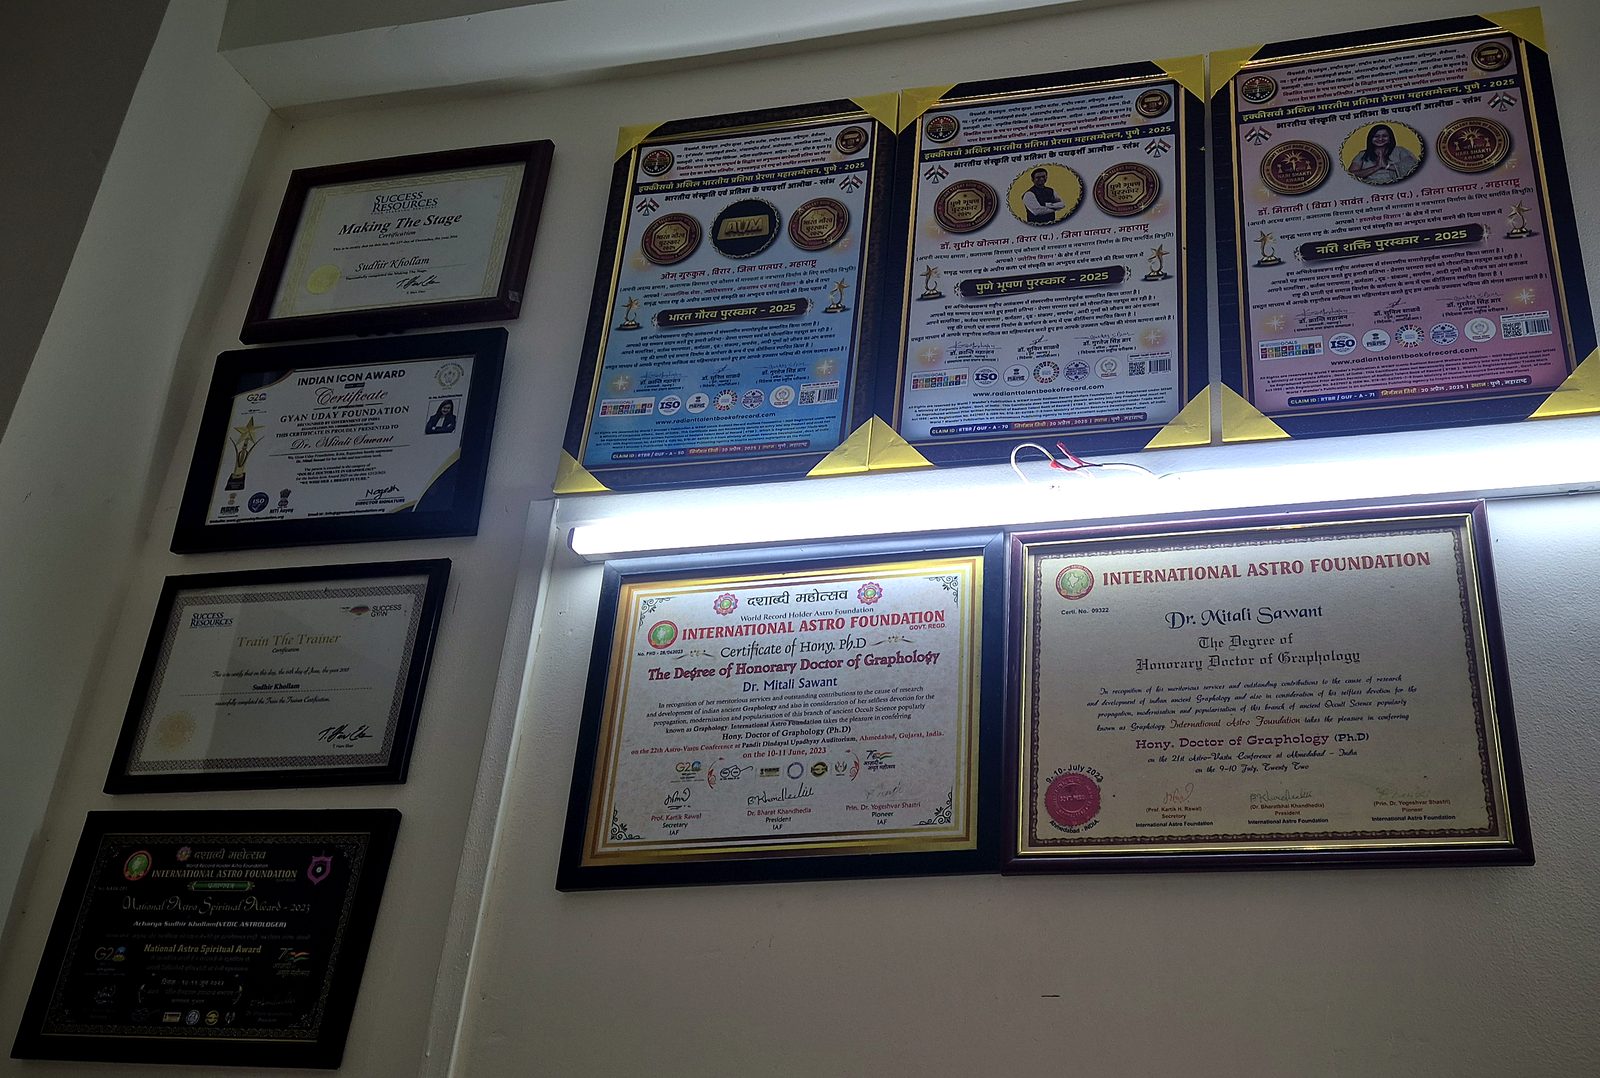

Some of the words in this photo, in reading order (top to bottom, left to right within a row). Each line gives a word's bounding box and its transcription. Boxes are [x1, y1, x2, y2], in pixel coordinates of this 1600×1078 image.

[1489, 78, 1515, 88] 2025
[1148, 125, 1172, 134] 2025
[844, 162, 865, 170] 2025
[375, 191, 424, 204] SUCCESS
[1421, 187, 1444, 197] जिला
[372, 198, 439, 213] RESOURCES
[338, 220, 392, 236] Making
[395, 217, 421, 229] The
[423, 213, 463, 227] Stage
[724, 216, 764, 235] AUM
[1316, 244, 1339, 254] नारी
[1343, 238, 1371, 252] शक्ति
[1375, 235, 1420, 251] पुरस्कार
[1434, 229, 1468, 241] 2025
[355, 258, 388, 272] Sudhir
[389, 256, 430, 269] Khollam
[976, 281, 993, 295] पुणे
[996, 280, 1024, 293] भूषण
[1026, 276, 1067, 290] पुरस्कार
[1079, 271, 1109, 282] 2025
[668, 312, 692, 322] भारत
[694, 308, 717, 320] गौरव
[720, 306, 757, 320] पुरस्कार
[769, 303, 796, 313] 2025
[1330, 338, 1355, 348] ISO
[298, 375, 334, 386] INDIAN
[336, 372, 363, 383] ICON
[364, 369, 406, 381] AWARD
[974, 372, 998, 381] ISO
[314, 386, 389, 407] Certificate
[659, 401, 681, 410] ISO
[280, 414, 308, 423] GYAN
[311, 411, 340, 421] UDAY
[341, 405, 410, 419] FOUNDATION
[1103, 563, 1242, 586] INTERNATIONAL
[1247, 559, 1305, 577] ASTRO
[1311, 551, 1431, 573] FOUNDATION
[747, 590, 790, 607] दशाब्दी
[795, 588, 849, 603] महोत्सव
[192, 612, 224, 620] SUCCESS
[740, 614, 762, 622] World
[763, 613, 787, 621] Record
[834, 607, 874, 615] Foundation
[1165, 611, 1196, 629] Dr.
[1201, 607, 1251, 626] Mitali
[1256, 605, 1323, 624] Sawant
[190, 618, 234, 627] RESOURCES
[682, 621, 795, 641] INTERNATIONAL
[799, 617, 846, 633] ASTRO
[850, 609, 945, 629] FOUNDATION
[237, 636, 269, 648] Train
[272, 632, 295, 646] The
[299, 633, 342, 645] Trainer
[720, 640, 782, 660] Certificate
[785, 637, 797, 657] of
[800, 640, 836, 654] Hony.
[839, 634, 867, 650] Ph.D
[1198, 636, 1224, 651] The
[1229, 634, 1276, 650] Degree
[1280, 632, 1294, 645] of
[648, 669, 671, 681] The
[673, 667, 716, 682] Degree
[718, 662, 734, 678] of
[735, 662, 797, 675] Honorary
[799, 658, 844, 671] Doctor
[846, 654, 862, 670] of
[863, 650, 941, 669] Graphology
[1135, 657, 1203, 674] Honorary
[1207, 654, 1255, 672] Doctor
[1259, 652, 1274, 665] of
[1278, 651, 1360, 666] Graphology
[742, 682, 759, 692] Dr.
[763, 679, 795, 691] Mitali
[798, 677, 838, 689] Sawant
[1376, 674, 1402, 682] research
[742, 704, 778, 713] Graphology
[898, 703, 926, 712] popularly
[1349, 699, 1373, 707] Science
[1376, 698, 1408, 708] popularly
[1169, 718, 1221, 729] International
[1226, 717, 1251, 727] Astro
[1255, 716, 1301, 727] Foundation
[722, 733, 743, 741] Hony.
[781, 727, 825, 738] Graphology
[826, 725, 852, 734] (Ph.D)
[1135, 739, 1175, 750] Hony.
[1179, 737, 1224, 748] Doctor
[1228, 736, 1243, 747] of
[1246, 733, 1330, 747] Graphology
[1334, 732, 1370, 742] (Ph.D)
[1286, 749, 1327, 759] Ahmedabad
[1068, 763, 1086, 773] July
[1262, 762, 1289, 773] Twenty
[1293, 761, 1310, 771] Two
[151, 869, 215, 879] INTERNATIONAL
[216, 869, 243, 878] ASTRO
[244, 868, 298, 879] FOUNDATION
[143, 944, 178, 953] National
[178, 945, 199, 953] Astro
[200, 945, 236, 955] Spiritual
[236, 945, 263, 953] Award
